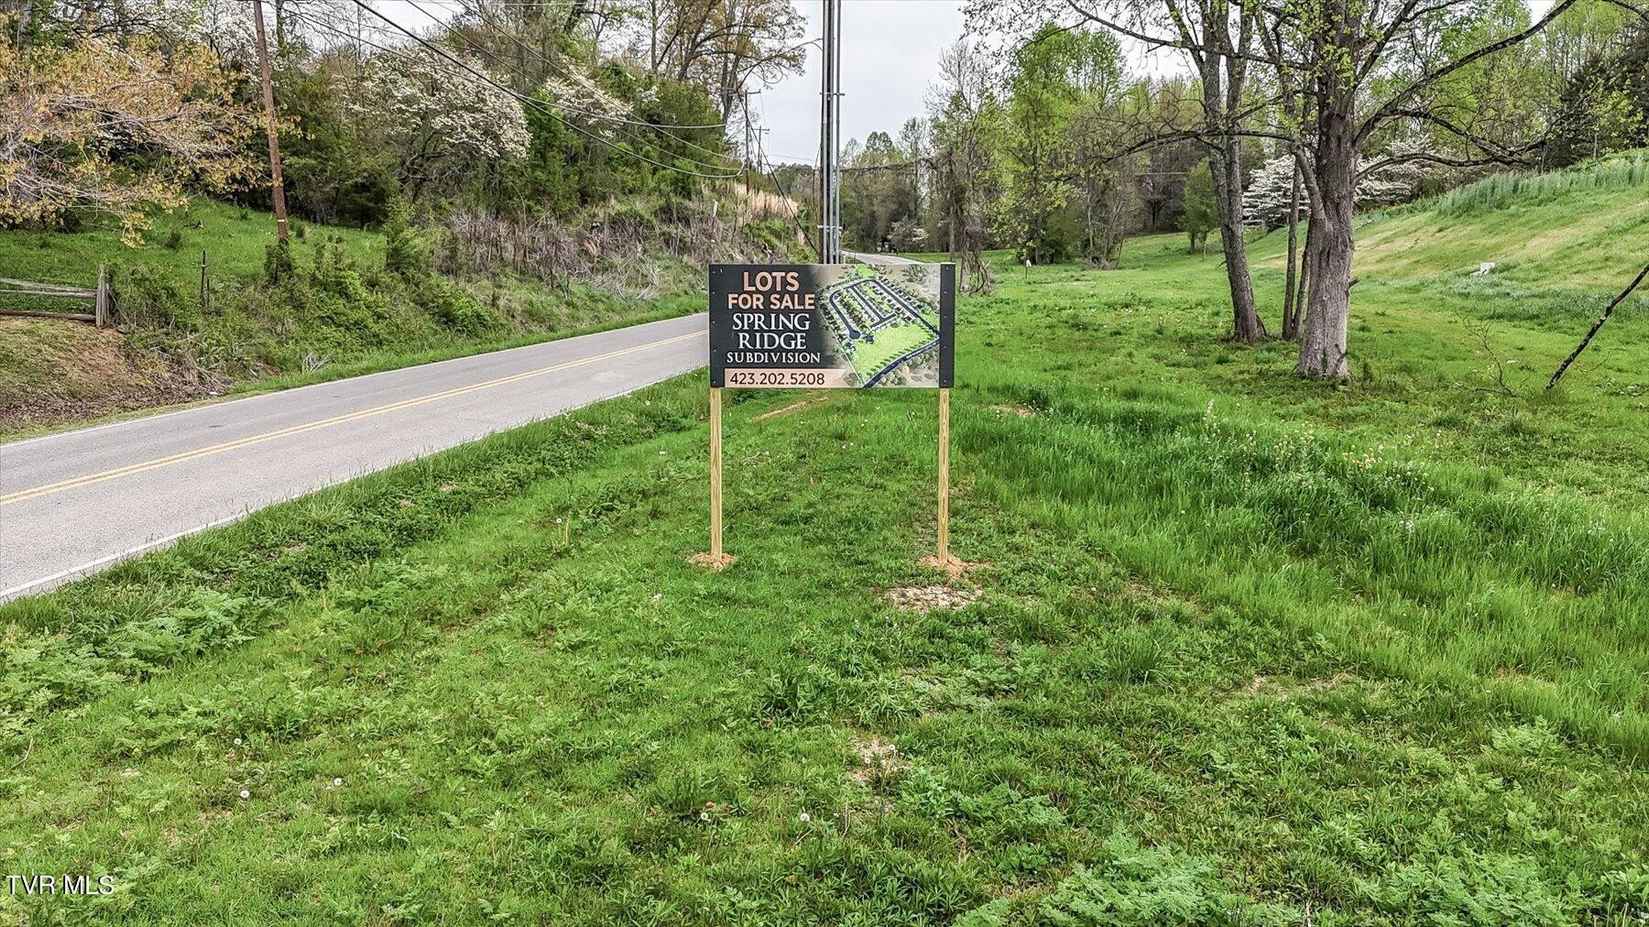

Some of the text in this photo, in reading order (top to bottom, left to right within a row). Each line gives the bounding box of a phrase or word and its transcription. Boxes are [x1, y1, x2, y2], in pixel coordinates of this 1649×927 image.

[743, 271, 800, 291] LOTS
[727, 293, 815, 309] FOR SALE
[732, 313, 811, 330] SPRING
[738, 332, 807, 350] RIDGE
[726, 352, 821, 363] SUBDIVISION
[730, 372, 825, 385] 423.202.5208
